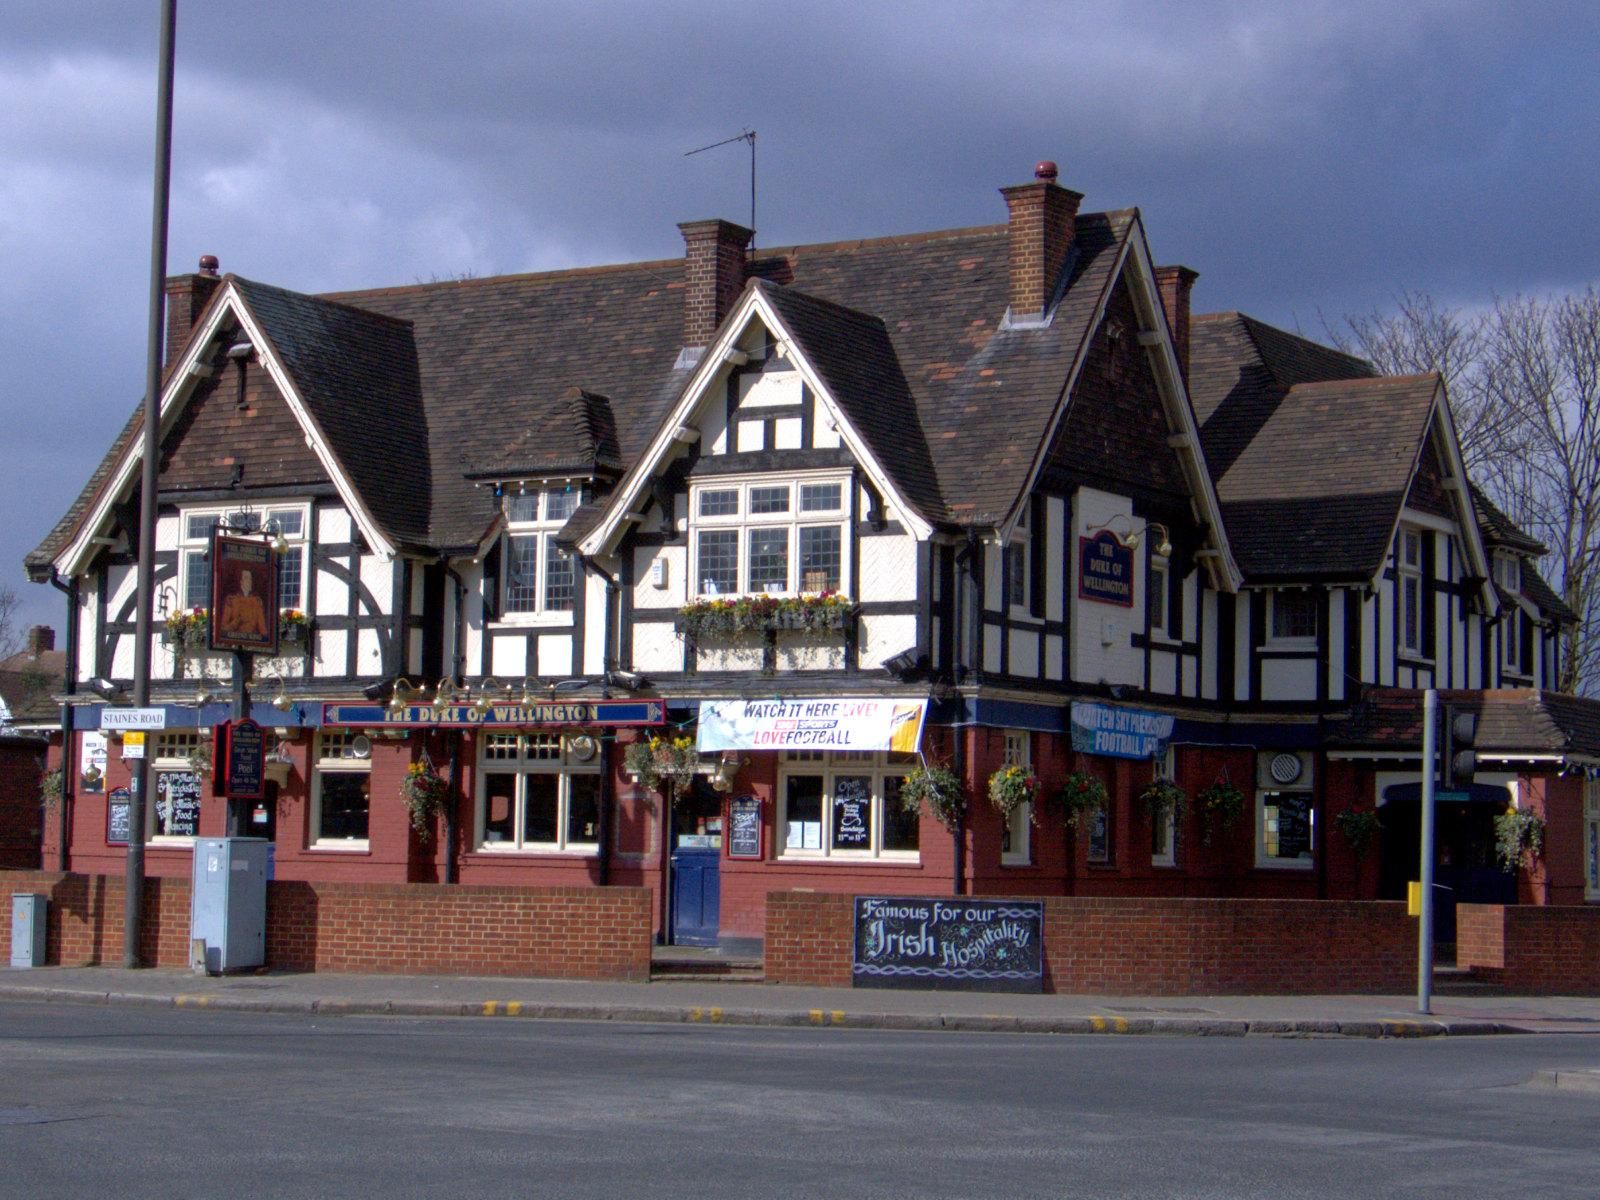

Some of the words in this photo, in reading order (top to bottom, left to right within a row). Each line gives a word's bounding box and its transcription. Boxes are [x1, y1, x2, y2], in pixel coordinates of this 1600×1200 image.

[1083, 576, 1129, 595] WELLINGTON
[104, 714, 138, 724] STAINES
[140, 714, 163, 724] ROAD
[384, 706, 411, 722] THE
[419, 706, 460, 722] DUKE
[493, 705, 599, 722] WELLINGTON
[744, 703, 786, 718] WATCH
[788, 703, 804, 717] IT
[805, 703, 839, 717] HERE
[1095, 730, 1141, 755] FOOTBALL
[237, 763, 253, 774] Pool
[861, 900, 929, 919] Famous
[930, 902, 962, 928] for
[965, 908, 997, 921] our
[868, 919, 936, 957] Irish
[941, 919, 1030, 967] Hospitality
